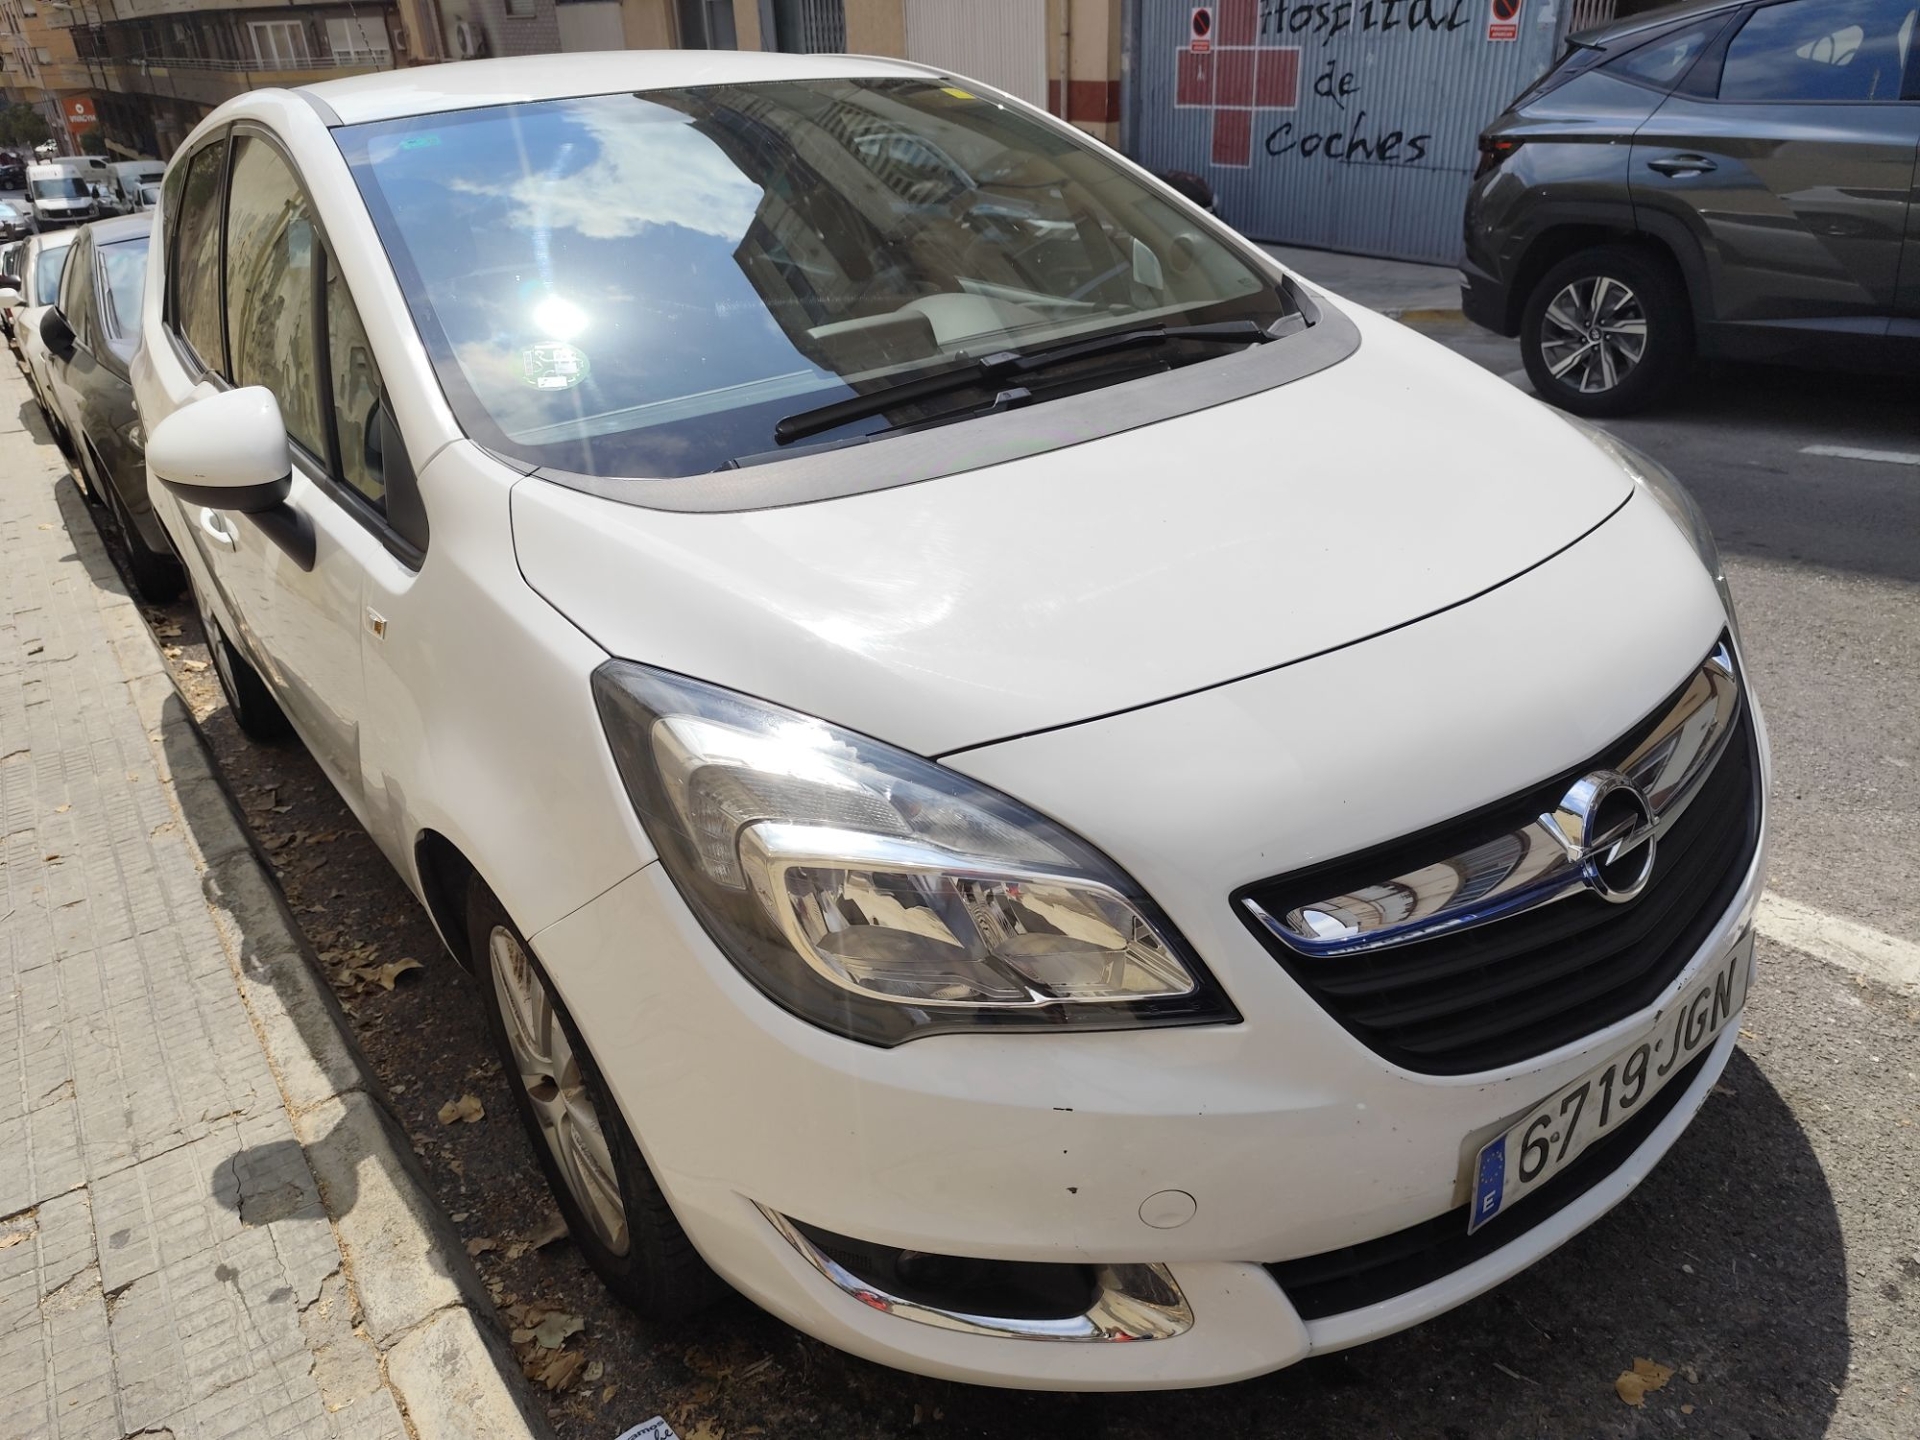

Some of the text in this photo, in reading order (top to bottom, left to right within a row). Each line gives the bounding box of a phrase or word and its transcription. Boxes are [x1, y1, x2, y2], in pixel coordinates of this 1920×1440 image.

[1260, 0, 1471, 47] Hospital
[1313, 60, 1360, 110] de
[1265, 111, 1431, 162] Coches
[1519, 957, 1737, 1184] 6719 JGN
[1482, 1190, 1496, 1213] E
